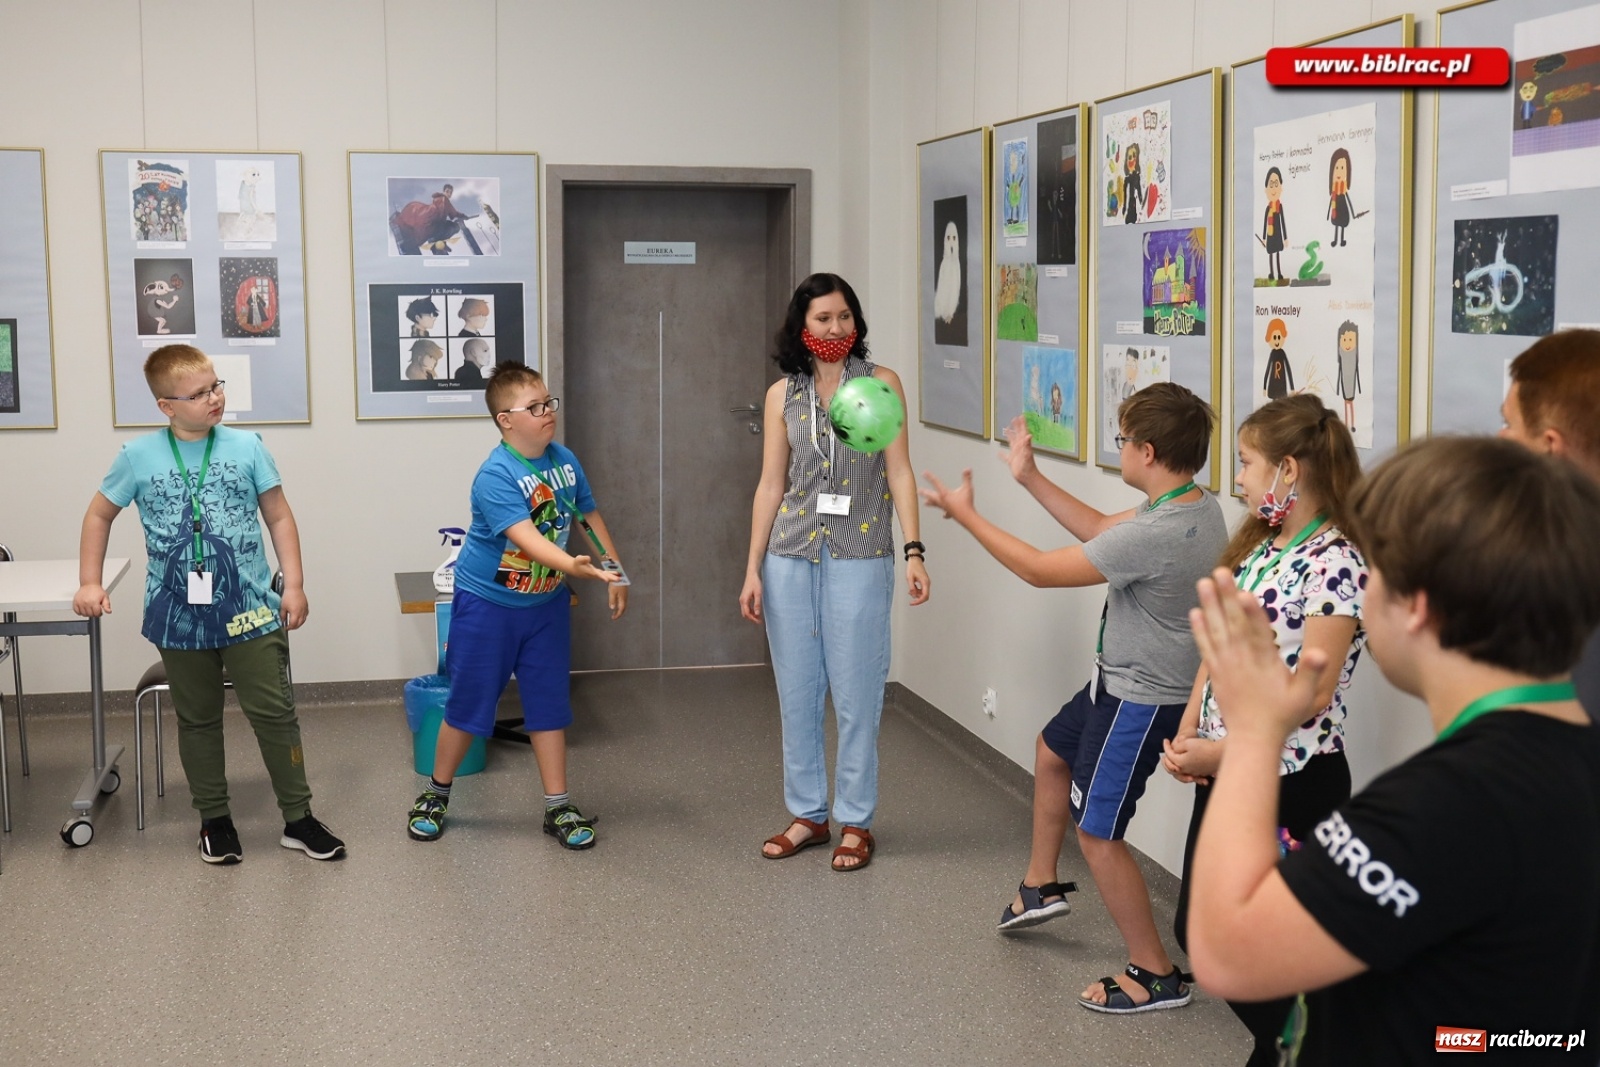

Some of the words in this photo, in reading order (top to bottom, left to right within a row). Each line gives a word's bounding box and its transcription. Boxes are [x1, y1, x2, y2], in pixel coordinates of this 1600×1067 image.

[1255, 305, 1269, 316] Ron
[1270, 304, 1301, 318] Weasley
[1314, 810, 1420, 918] ERROR
